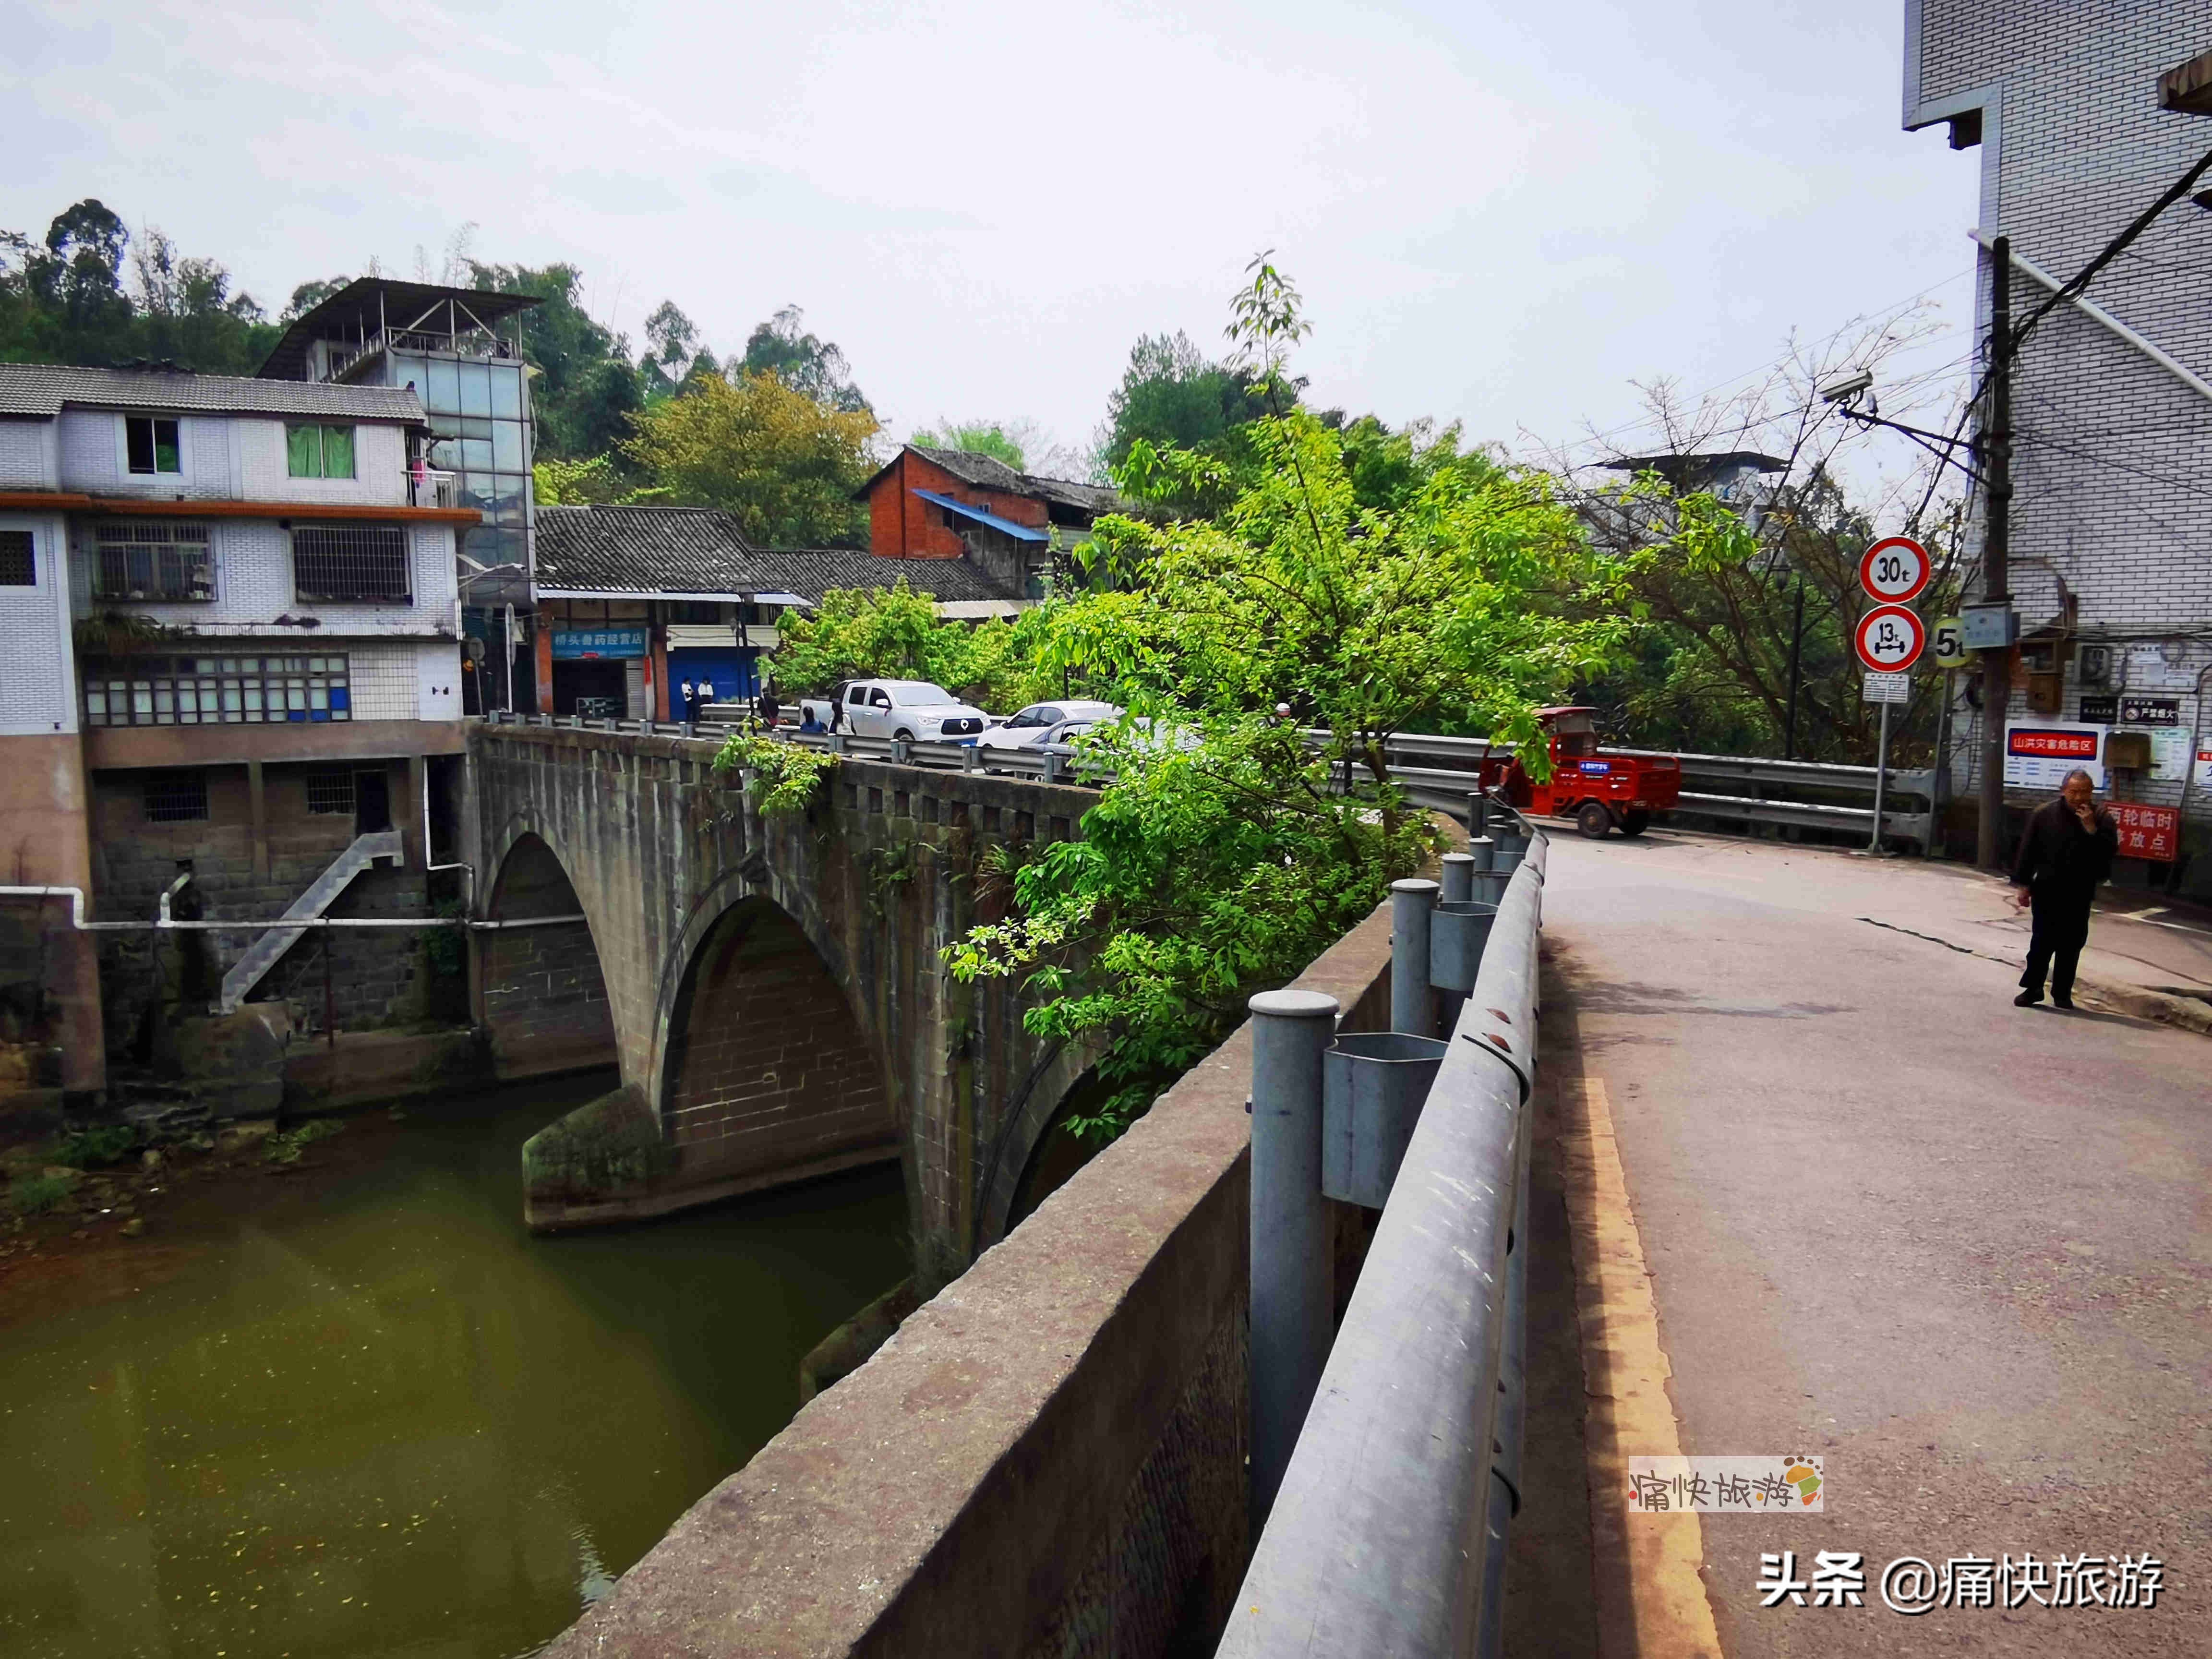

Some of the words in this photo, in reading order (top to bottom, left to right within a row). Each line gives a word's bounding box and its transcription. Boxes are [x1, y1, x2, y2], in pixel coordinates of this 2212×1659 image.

[1877, 557, 1910, 583] 30t
[1879, 623, 1899, 642] 13t
[1936, 628, 1965, 657] 5t
[2014, 738, 2092, 751] 山洪灾害危险区
